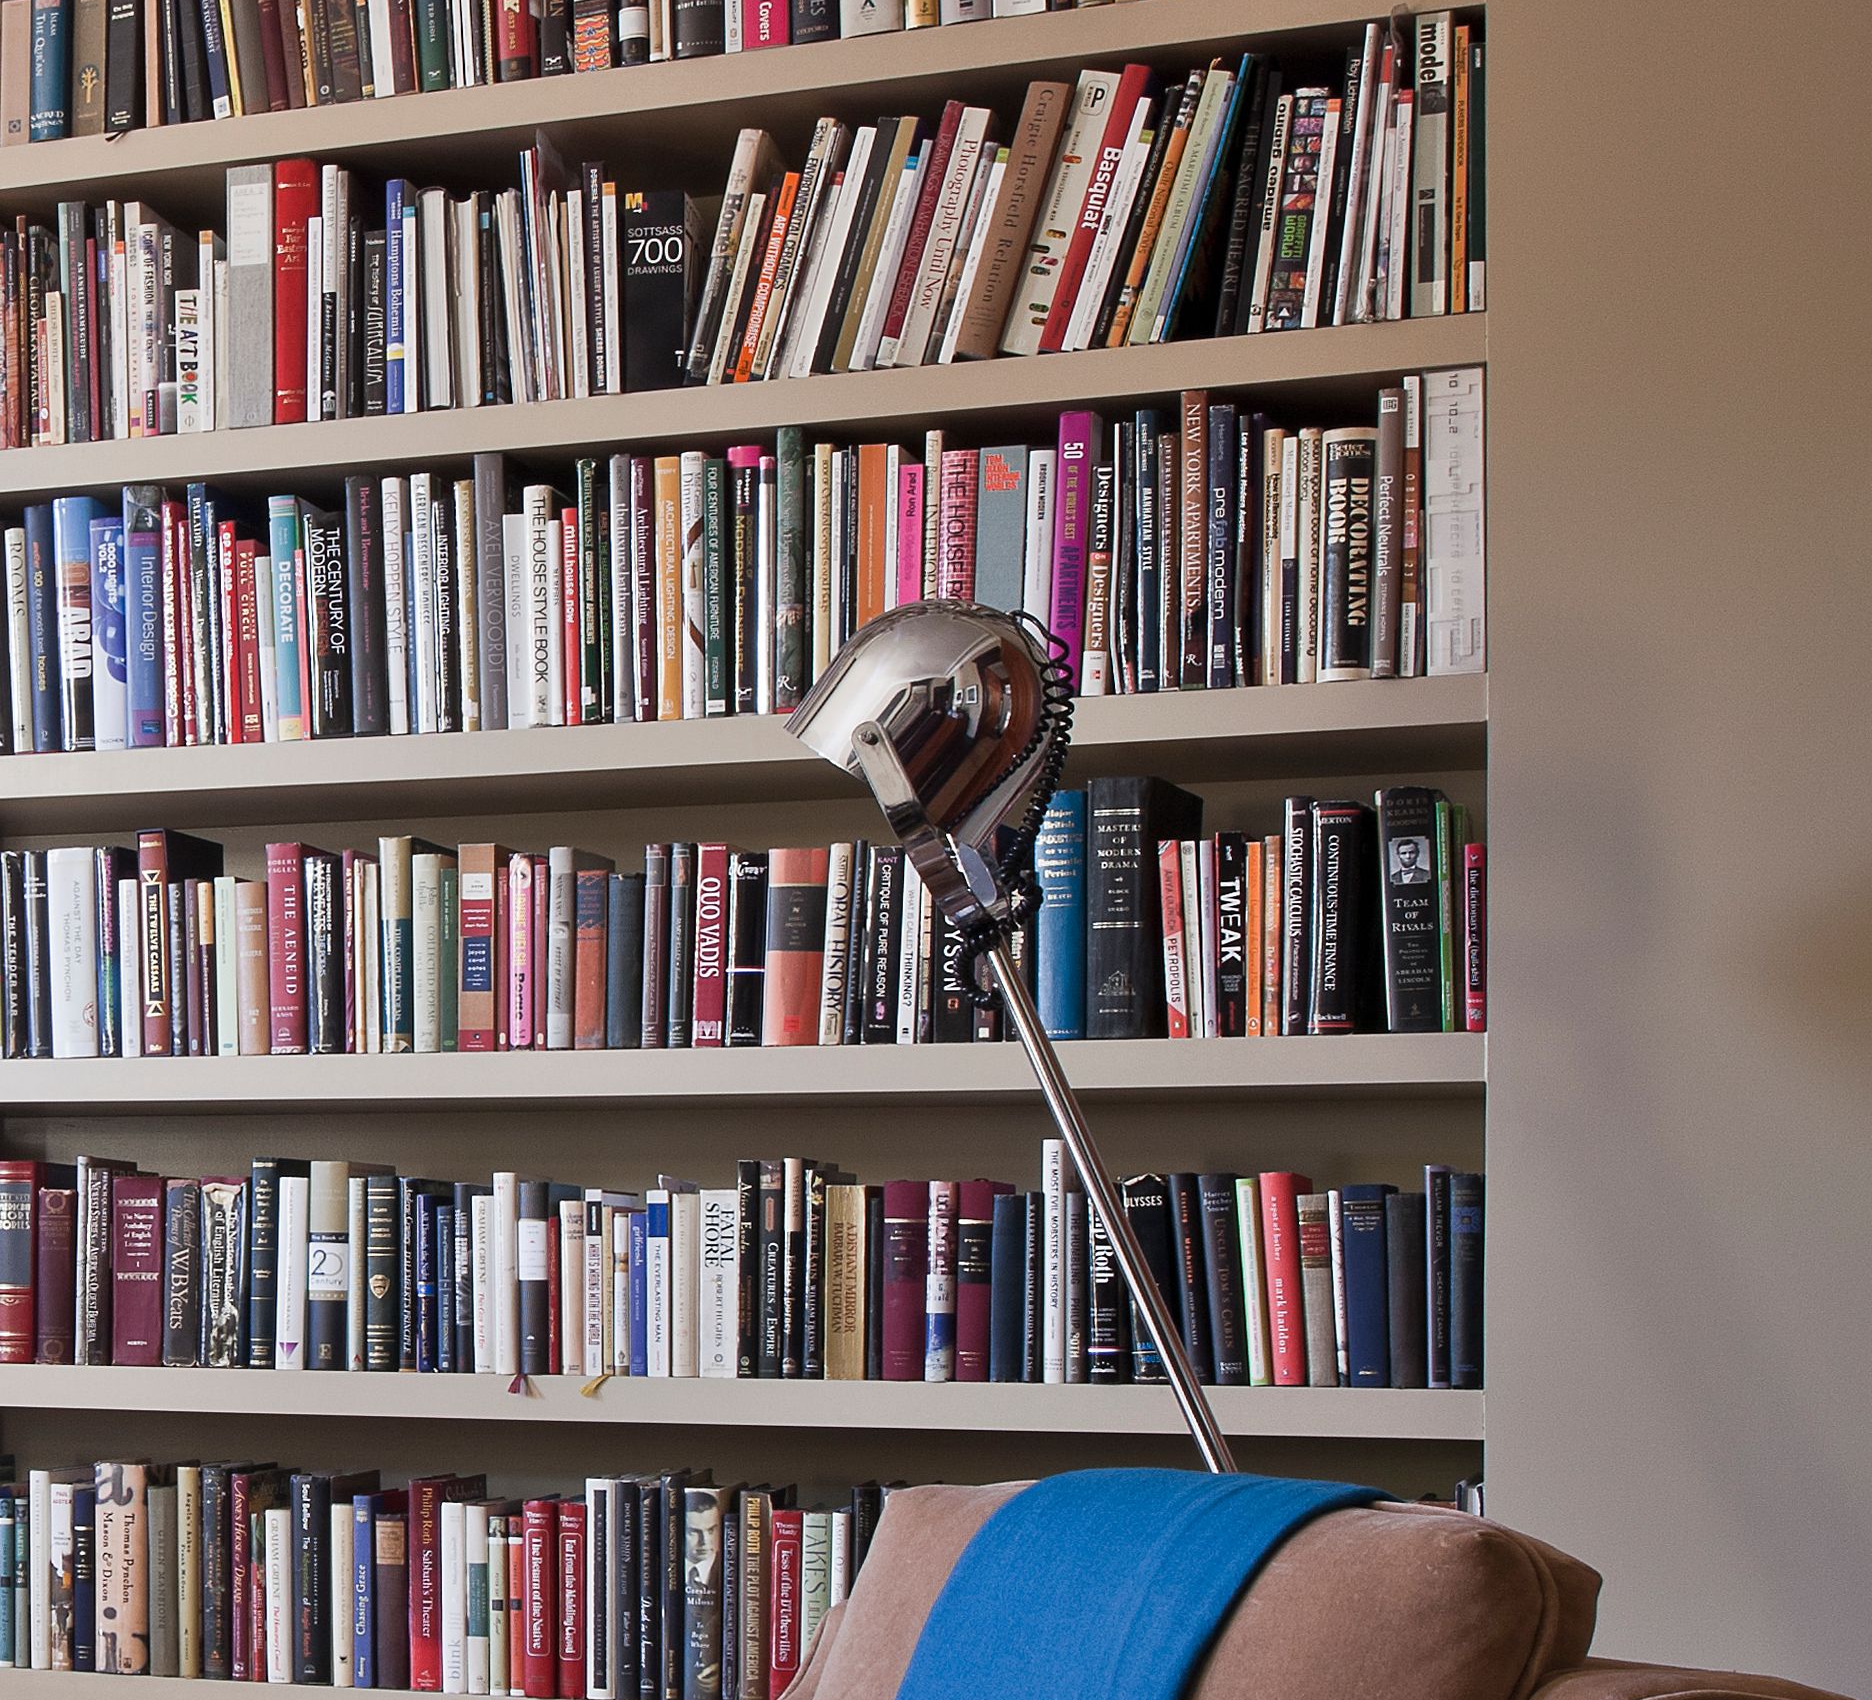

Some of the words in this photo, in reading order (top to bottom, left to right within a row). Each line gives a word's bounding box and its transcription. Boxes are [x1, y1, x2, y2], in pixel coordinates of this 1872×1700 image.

[758, 2, 770, 41] Covers
[1419, 23, 1444, 84] model
[941, 139, 977, 234] Photography
[1080, 146, 1120, 229] Basquiat
[627, 227, 681, 237] SOTTSASS
[628, 239, 681, 263] 700
[389, 230, 401, 286] Hamptons
[627, 266, 681, 275] DRAWINGS
[930, 237, 950, 274] Until
[390, 288, 401, 337] Bohemia
[920, 277, 941, 310] Now
[1185, 403, 1199, 445] NEW
[1063, 442, 1083, 459] 50
[1185, 449, 1199, 494] YORK
[531, 498, 545, 528] THE
[1092, 466, 1111, 550] Designers
[1377, 475, 1393, 521] Perfect
[531, 531, 545, 584] HOUSE
[1185, 501, 1200, 608] APARTMENTS
[1376, 524, 1392, 577] Neutrals
[139, 556, 156, 609] Interior
[277, 561, 293, 643] DECORATE
[532, 587, 546, 636] STYLE
[1089, 565, 1108, 648] Designers
[139, 612, 157, 661] Design
[533, 639, 547, 683] BOOK
[283, 885, 295, 921] THE
[699, 877, 720, 920] QUO
[878, 864, 890, 910] CRITIQUE
[877, 928, 888, 955] PURE
[878, 913, 889, 926] OF
[1220, 880, 1241, 962] TWEAK
[284, 927, 296, 995] AENEID
[699, 924, 719, 978] VADIS
[1167, 937, 1180, 1003] PETROPOLIS
[1323, 942, 1337, 991] FINANCE
[875, 958, 887, 997] REASON
[704, 1202, 718, 1267] SHORE
[719, 1209, 734, 1267] FATAL
[845, 1222, 855, 1233] A
[845, 1235, 855, 1282] DISTANT
[844, 1284, 855, 1333] MIRROR
[1274, 1278, 1285, 1307] mark
[1275, 1310, 1287, 1354] haddon
[420, 1487, 431, 1517] Philip
[747, 1498, 759, 1527] PHILIP
[121, 1513, 134, 1555] Thomas
[421, 1520, 431, 1545] Roth
[747, 1530, 758, 1553] ROTH
[120, 1558, 133, 1604] Pynchon
[747, 1556, 758, 1573] THE
[747, 1576, 758, 1597] PLOT
[421, 1598, 431, 1637] Theater
[746, 1600, 758, 1638] AGAINST
[746, 1640, 758, 1680] AMERICA
